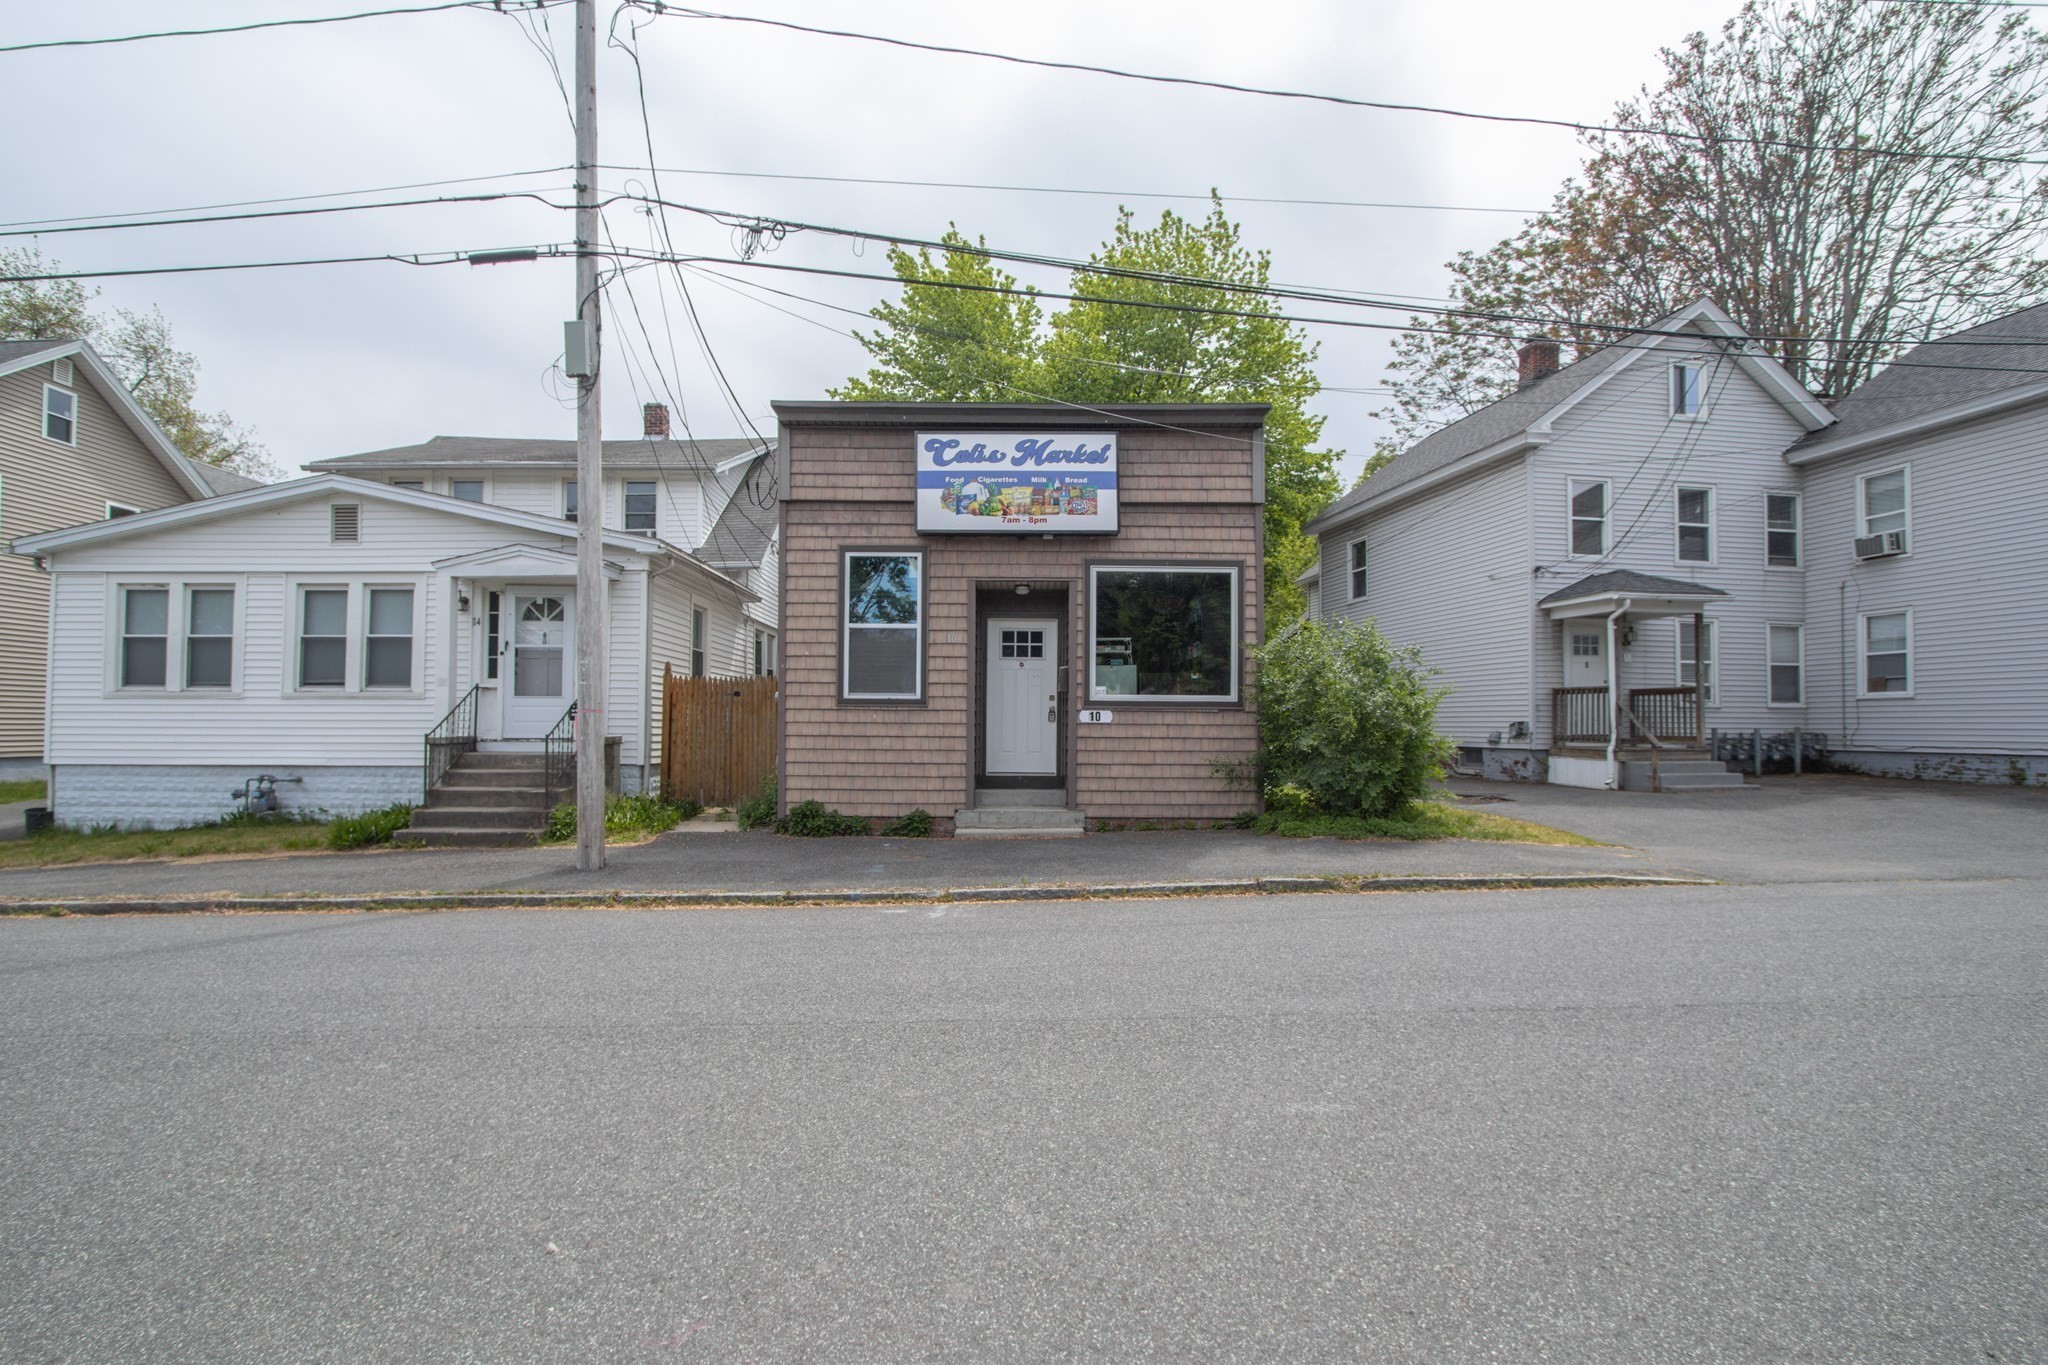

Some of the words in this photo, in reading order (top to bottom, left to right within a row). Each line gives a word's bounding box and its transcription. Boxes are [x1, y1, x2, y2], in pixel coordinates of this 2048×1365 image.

[1011, 438, 1112, 467] Market
[977, 476, 1018, 484] Cigarettes
[1001, 516, 1020, 524] 7am
[1028, 516, 1048, 525] 8pm
[1089, 711, 1101, 722] 10
